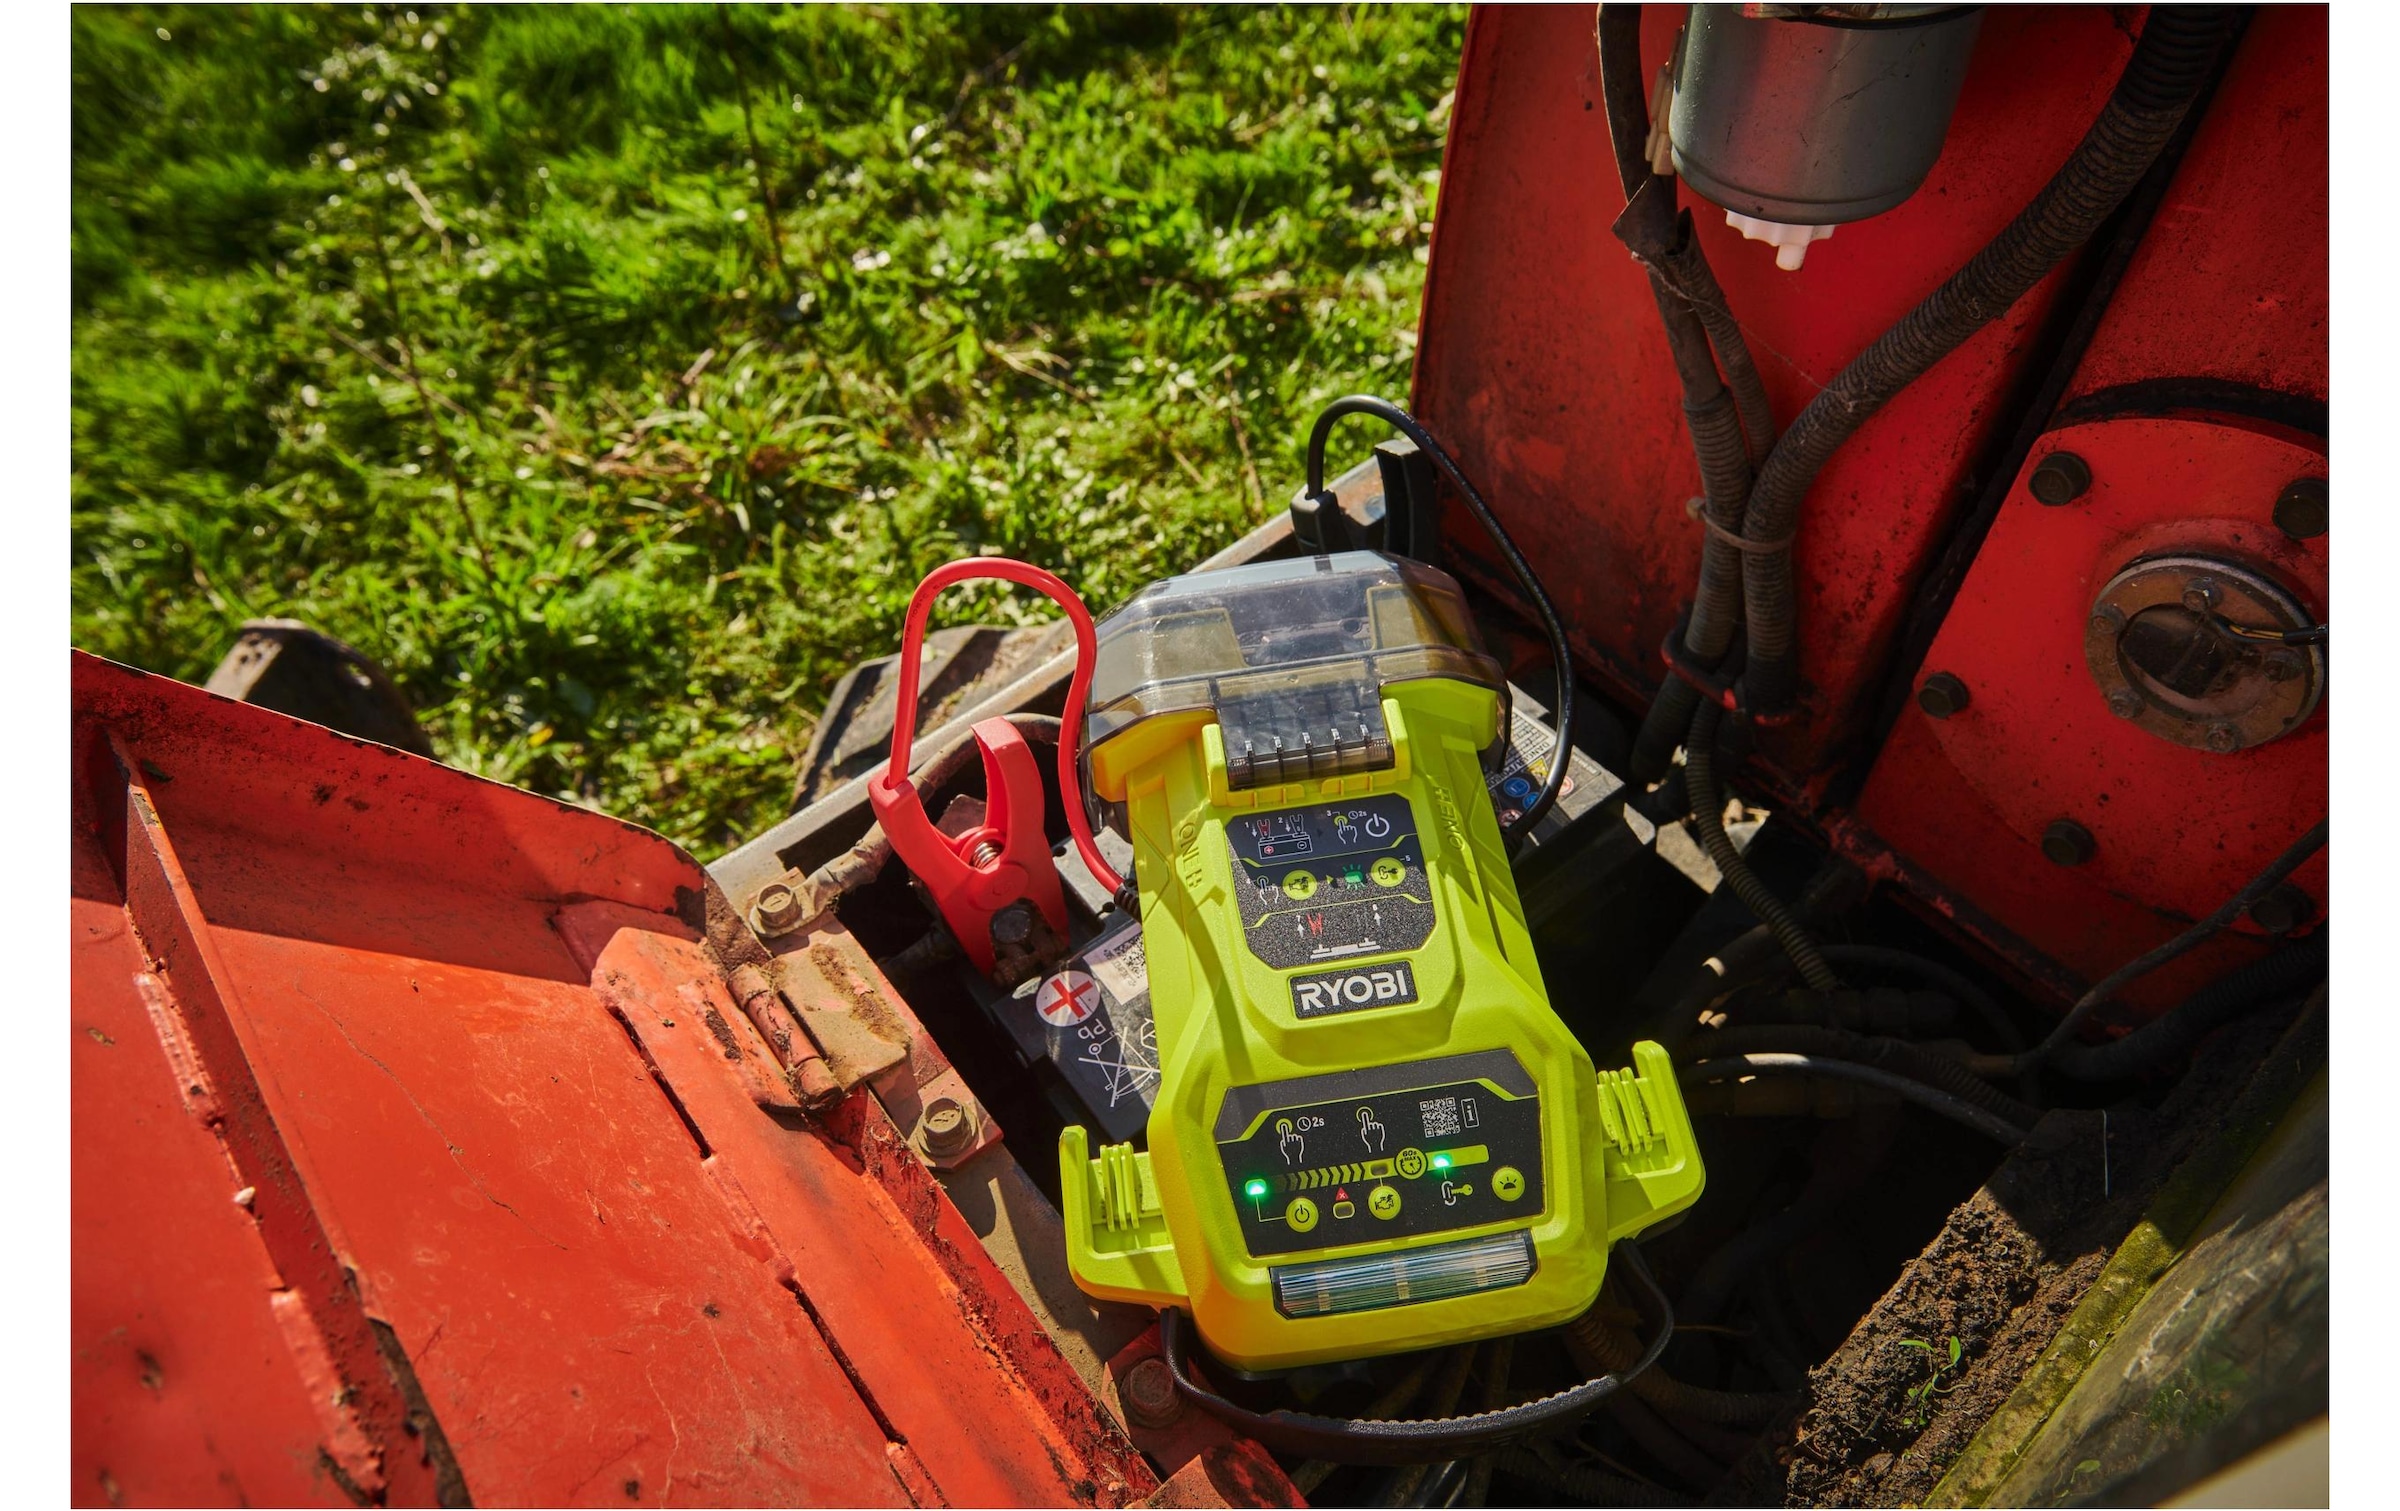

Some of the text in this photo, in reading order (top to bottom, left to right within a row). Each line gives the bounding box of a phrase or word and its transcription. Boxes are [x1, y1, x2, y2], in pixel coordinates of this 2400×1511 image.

[1326, 809, 1332, 817] 3
[1358, 810, 1368, 818] 2s
[1277, 816, 1284, 824] 2
[1404, 854, 1411, 862] 5
[1296, 969, 1408, 1011] RYOBI
[1077, 1017, 1107, 1040] Pb
[1311, 1116, 1325, 1128] 2s
